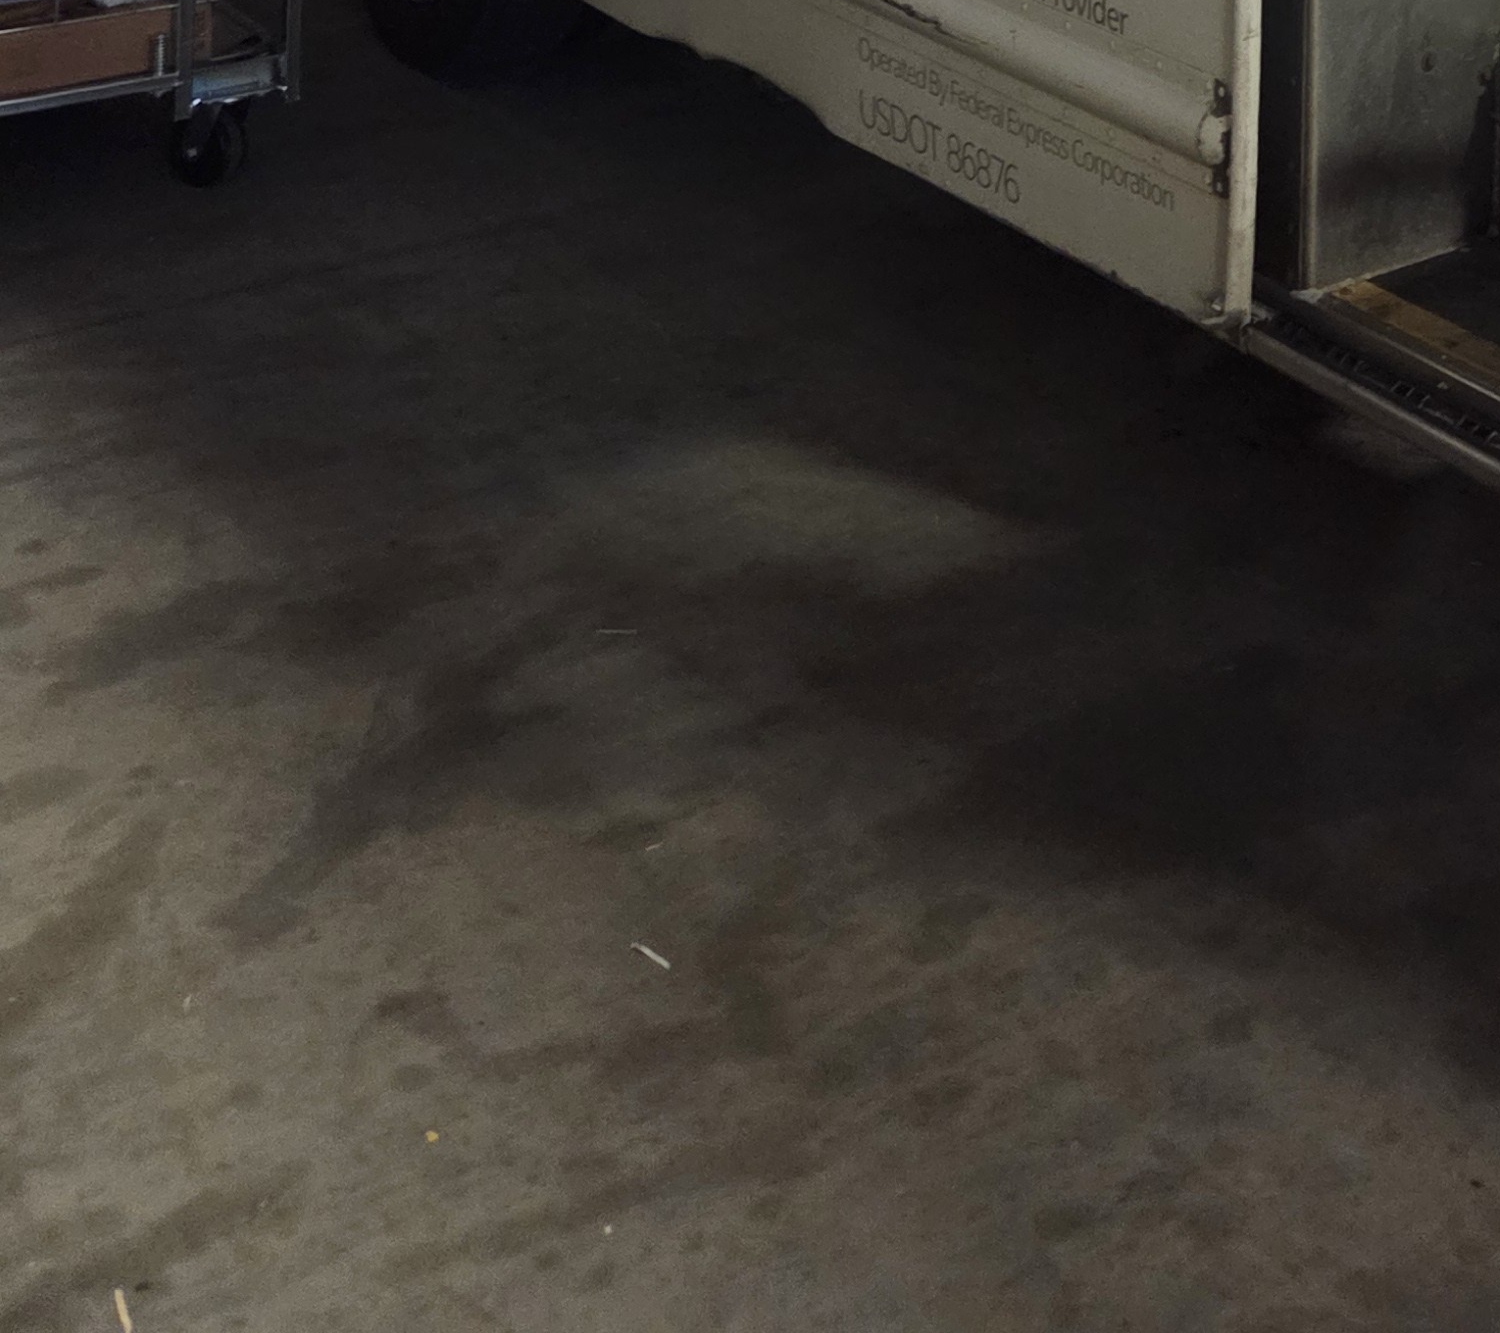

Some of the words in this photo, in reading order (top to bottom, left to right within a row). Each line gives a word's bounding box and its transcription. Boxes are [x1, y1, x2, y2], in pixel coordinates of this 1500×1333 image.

[858, 89, 942, 161] USDOT
[946, 133, 1021, 204] 86876
[949, 80, 1005, 129] Federal
[1072, 139, 1175, 211] Corporation
